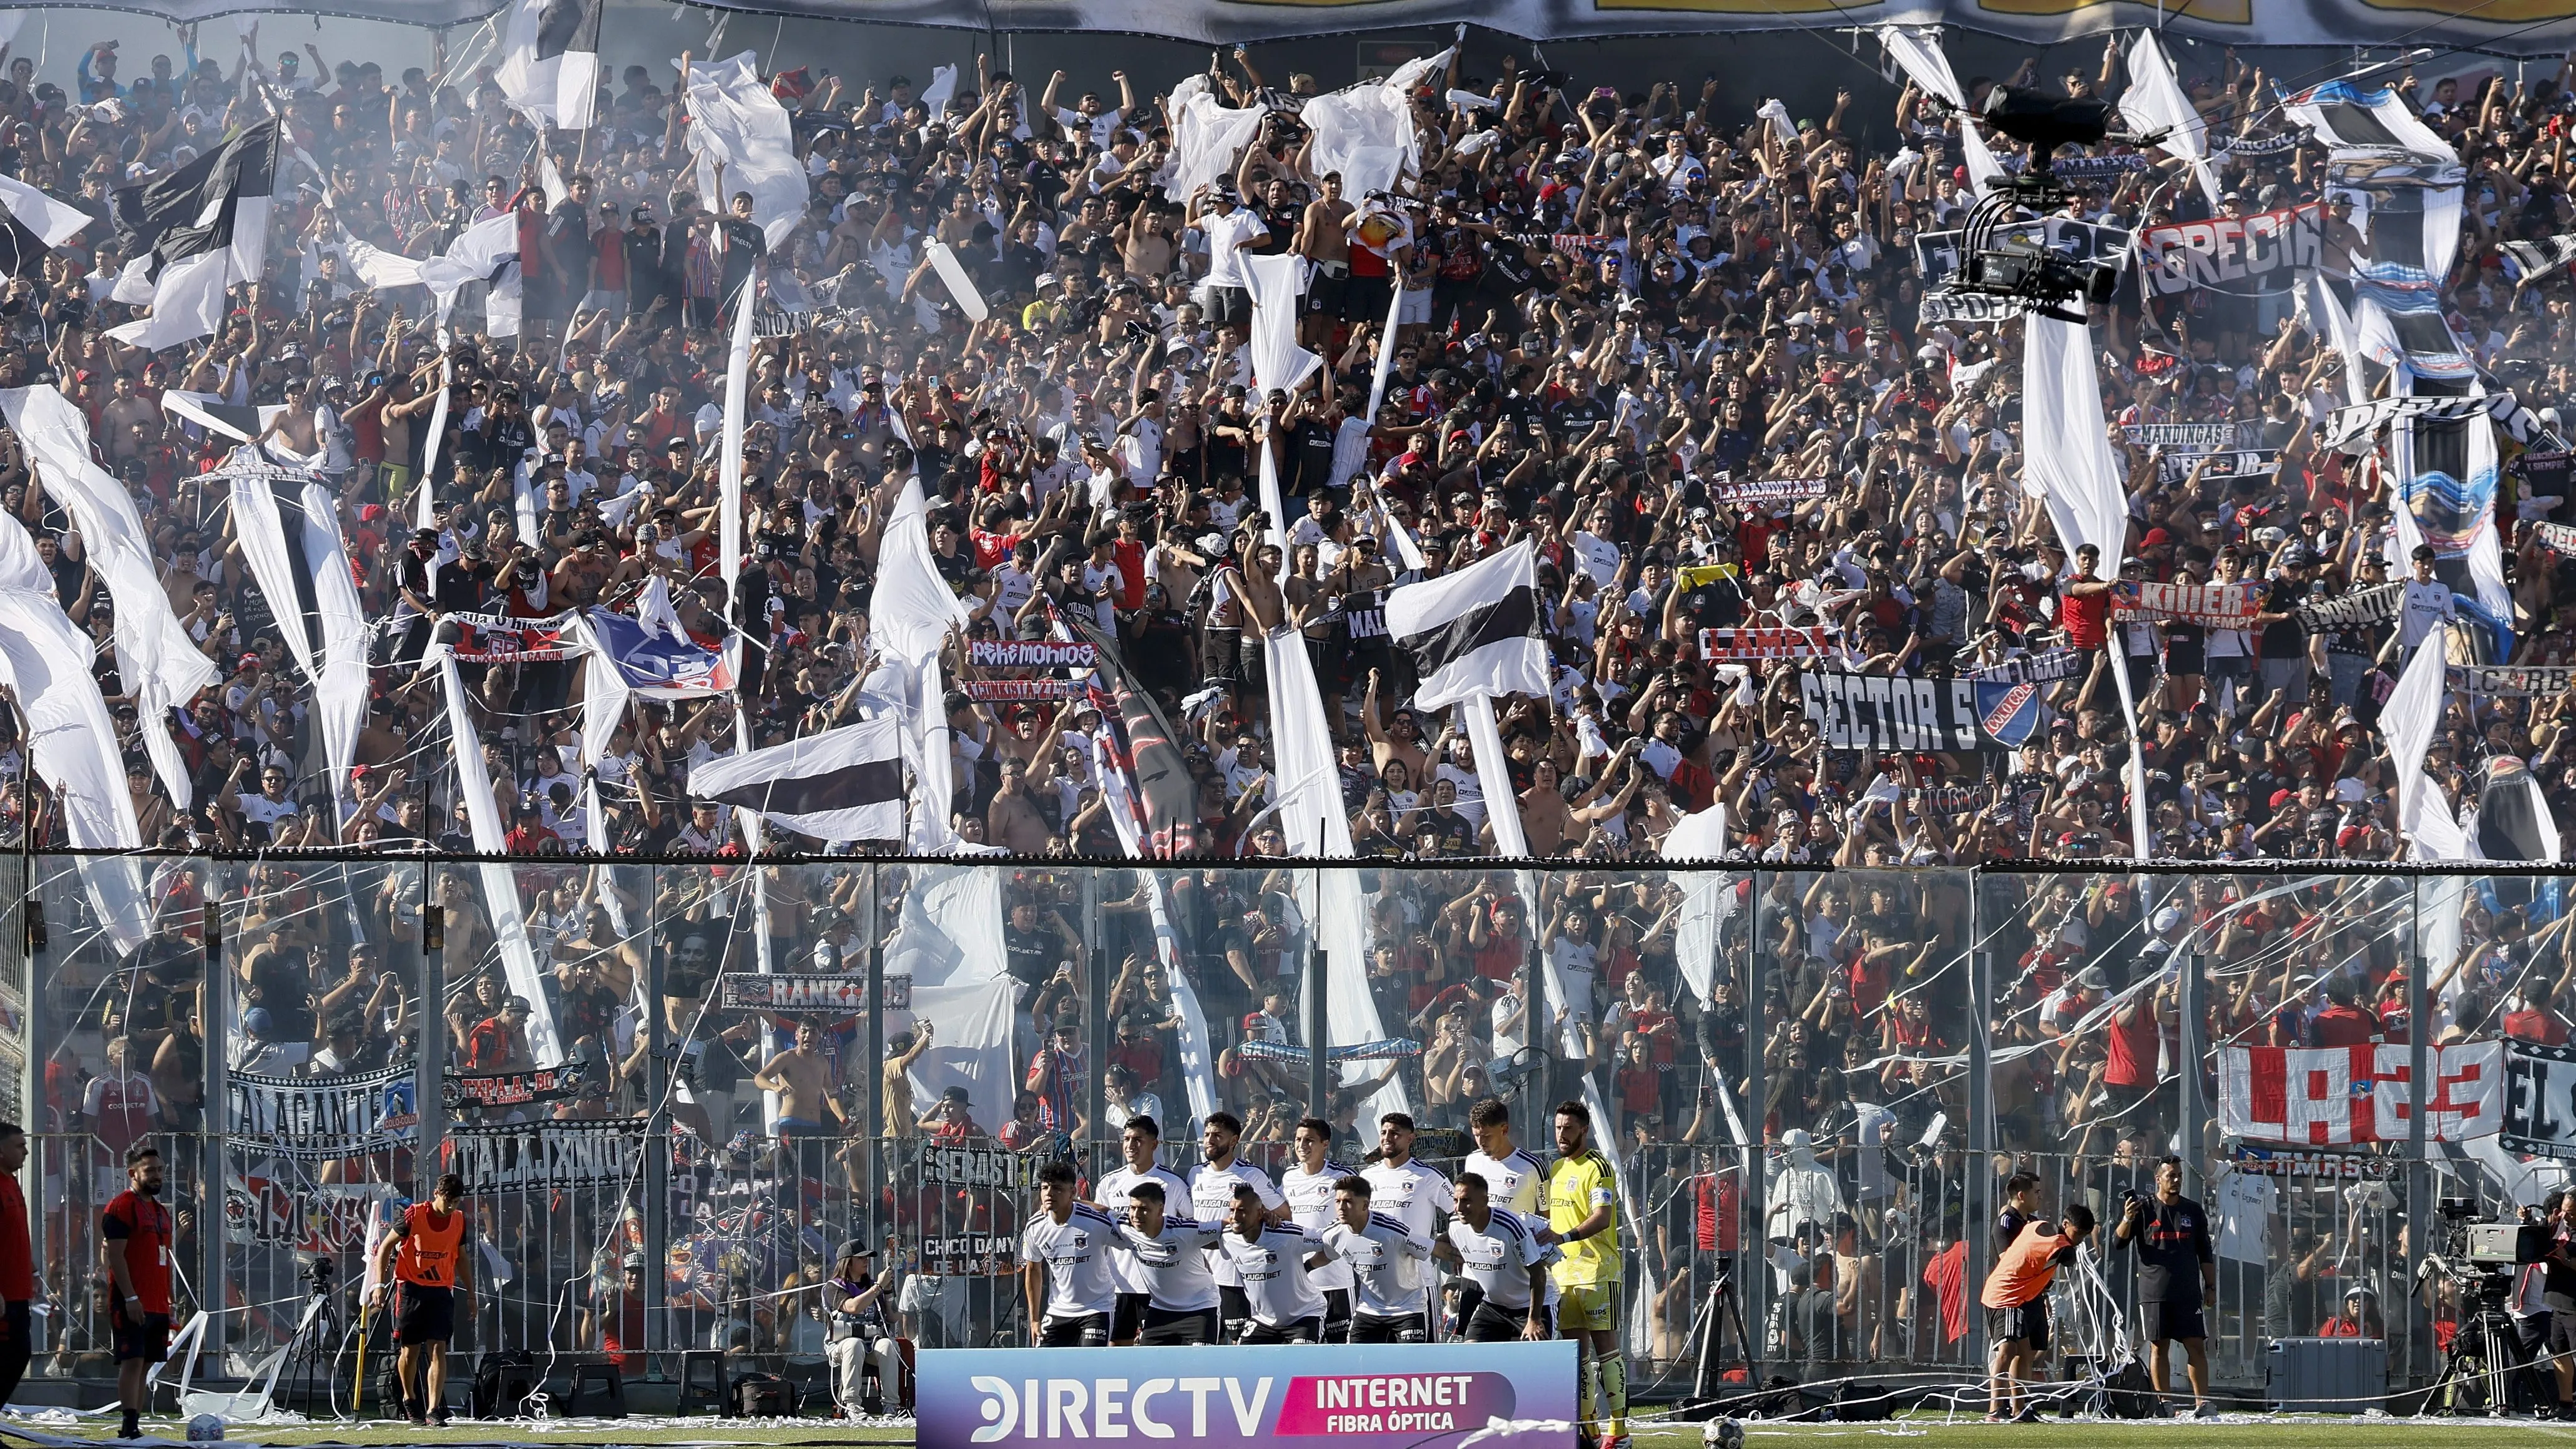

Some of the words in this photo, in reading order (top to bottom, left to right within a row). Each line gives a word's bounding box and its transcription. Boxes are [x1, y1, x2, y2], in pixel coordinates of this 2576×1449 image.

[2141, 425, 2222, 444] MANDINGAS
[1709, 626, 1830, 657] LAMPA
[1801, 671, 1942, 750] SECTOR
[1951, 679, 1977, 750] 5
[482, 1096, 495, 1106] EL
[497, 1093, 534, 1104] MONTE
[227, 1079, 384, 1150] TALAGANTE
[1537, 1184, 1547, 1206] tenpo
[924, 1237, 967, 1255] CHICO
[974, 1236, 1016, 1254] DANY
[1406, 1239, 1428, 1252] tenpo
[959, 1260, 980, 1274] LA
[1326, 1319, 1350, 1330] PHILIPS
[1400, 1329, 1424, 1337] PHILIPS
[1316, 1375, 1472, 1409] INTERNET
[971, 1376, 1273, 1443] DIRECTV
[1326, 1414, 1383, 1433] FIBRA
[1388, 1409, 1454, 1432] ÓPTICA
